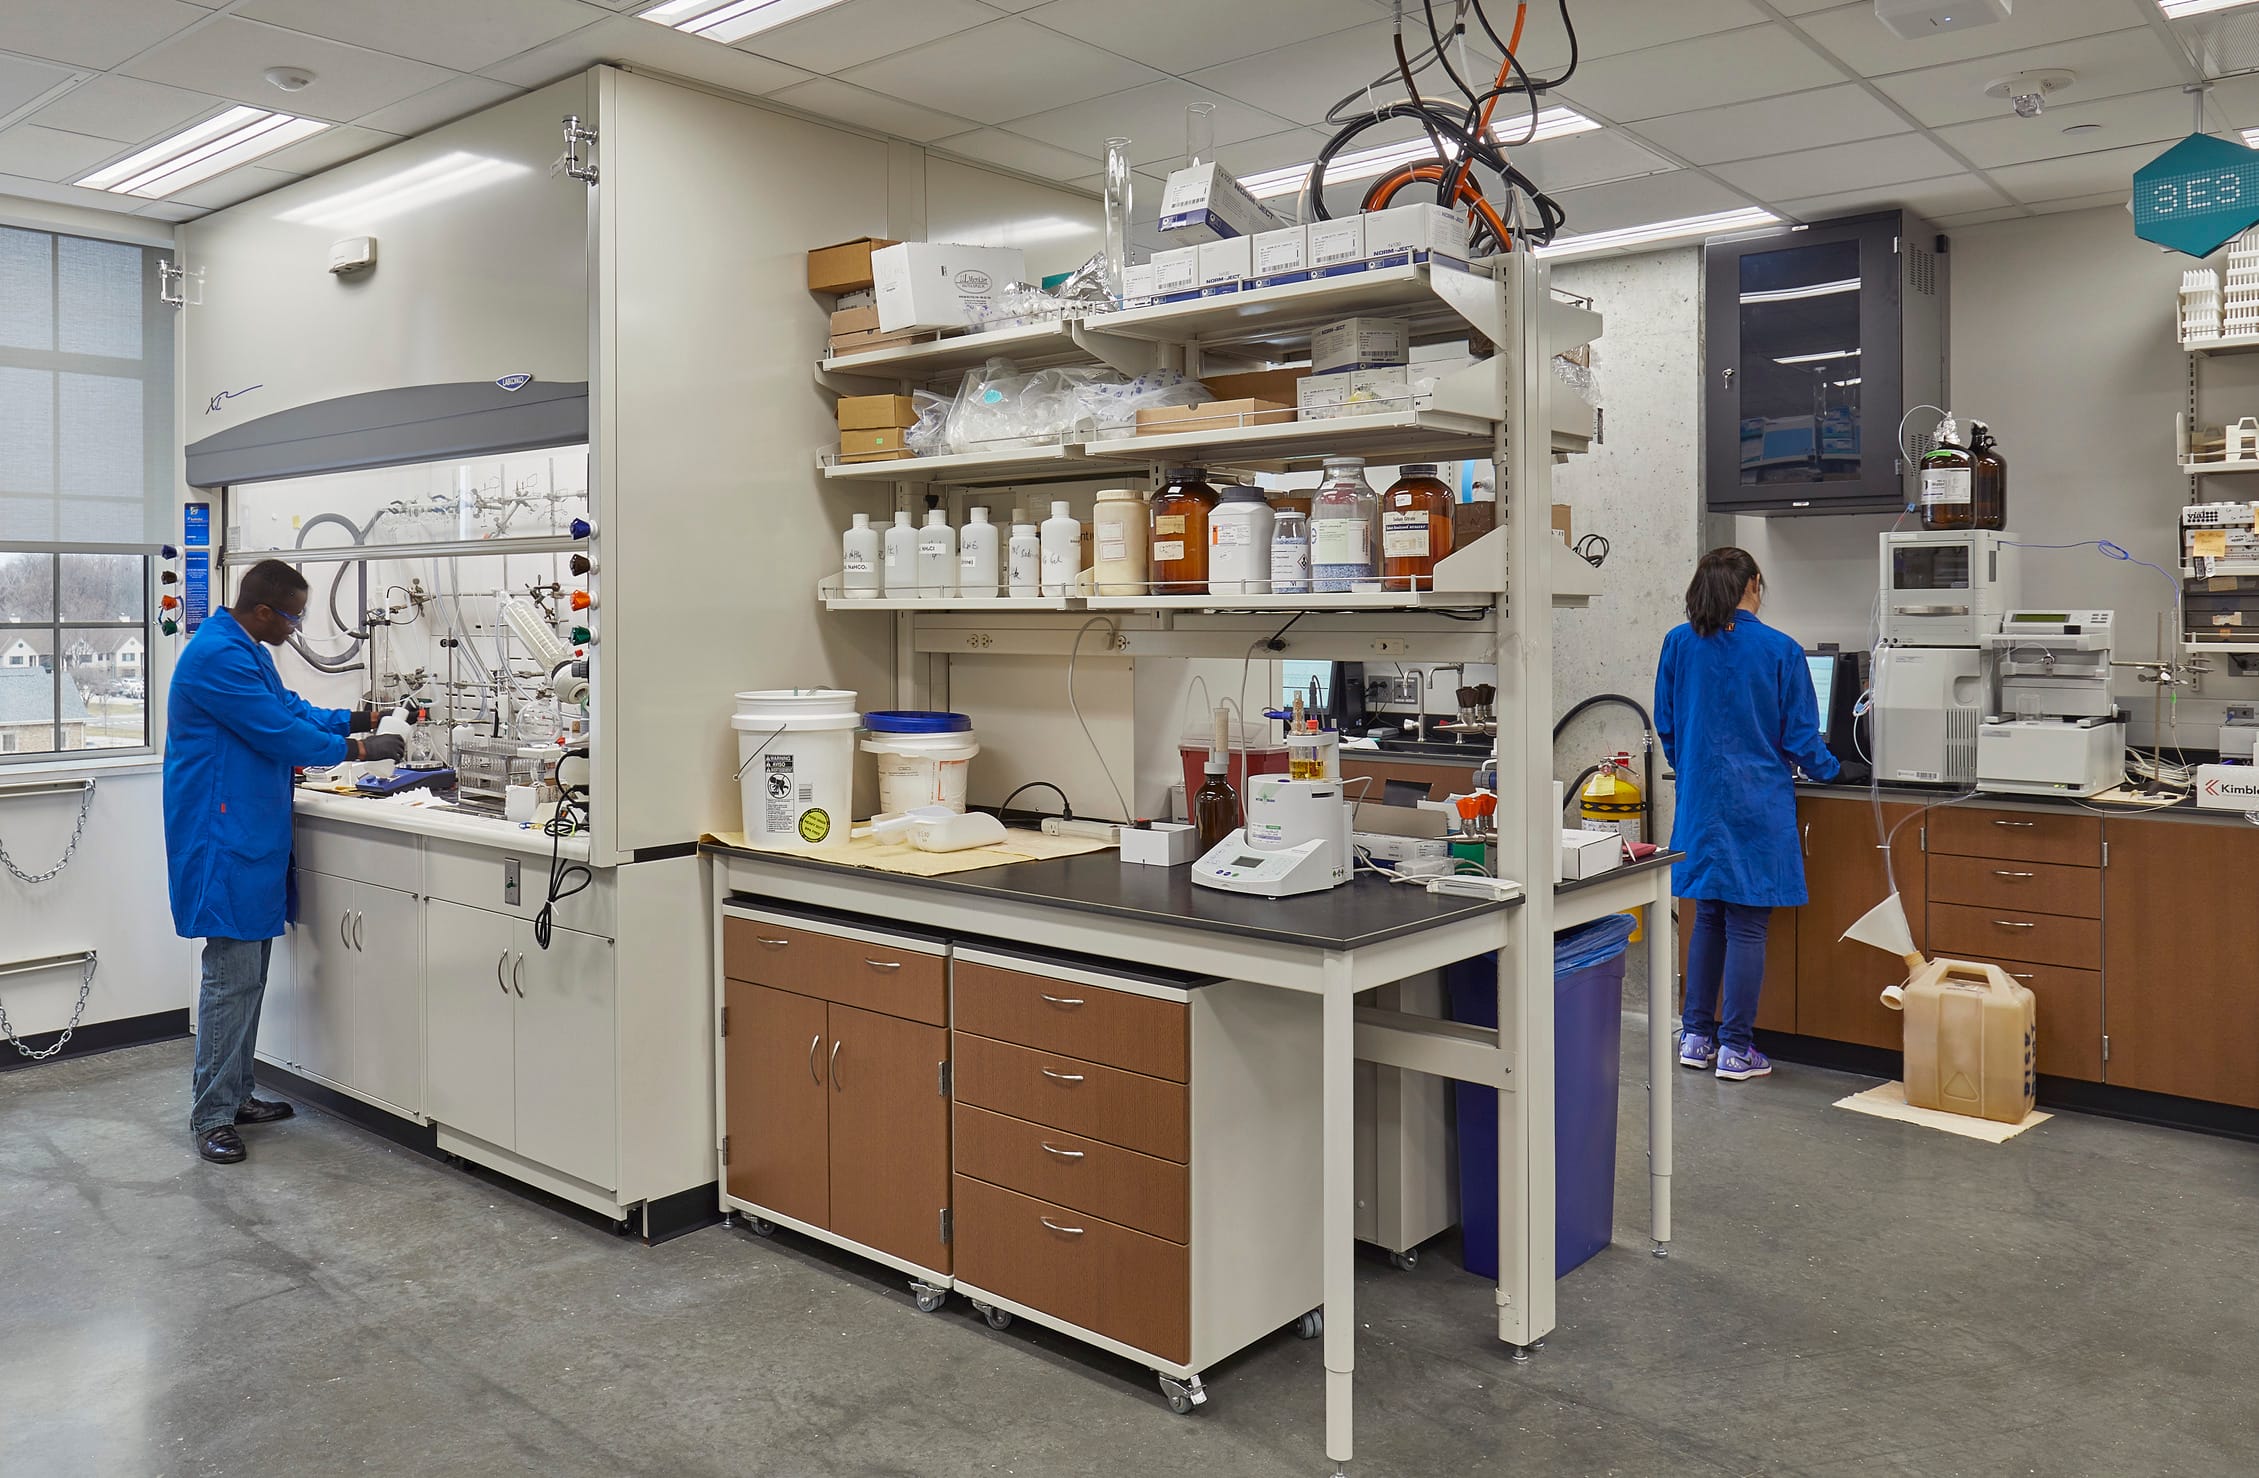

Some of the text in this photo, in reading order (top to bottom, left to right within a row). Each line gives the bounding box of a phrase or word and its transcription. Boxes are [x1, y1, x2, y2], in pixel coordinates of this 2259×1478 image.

[2153, 173, 2241, 214] 3E3
[1234, 182, 1275, 220] NORM-JECT
[1373, 244, 1414, 257] NORM-JECT
[1205, 273, 1241, 284] NORM-JECT
[2187, 511, 2206, 519] vial
